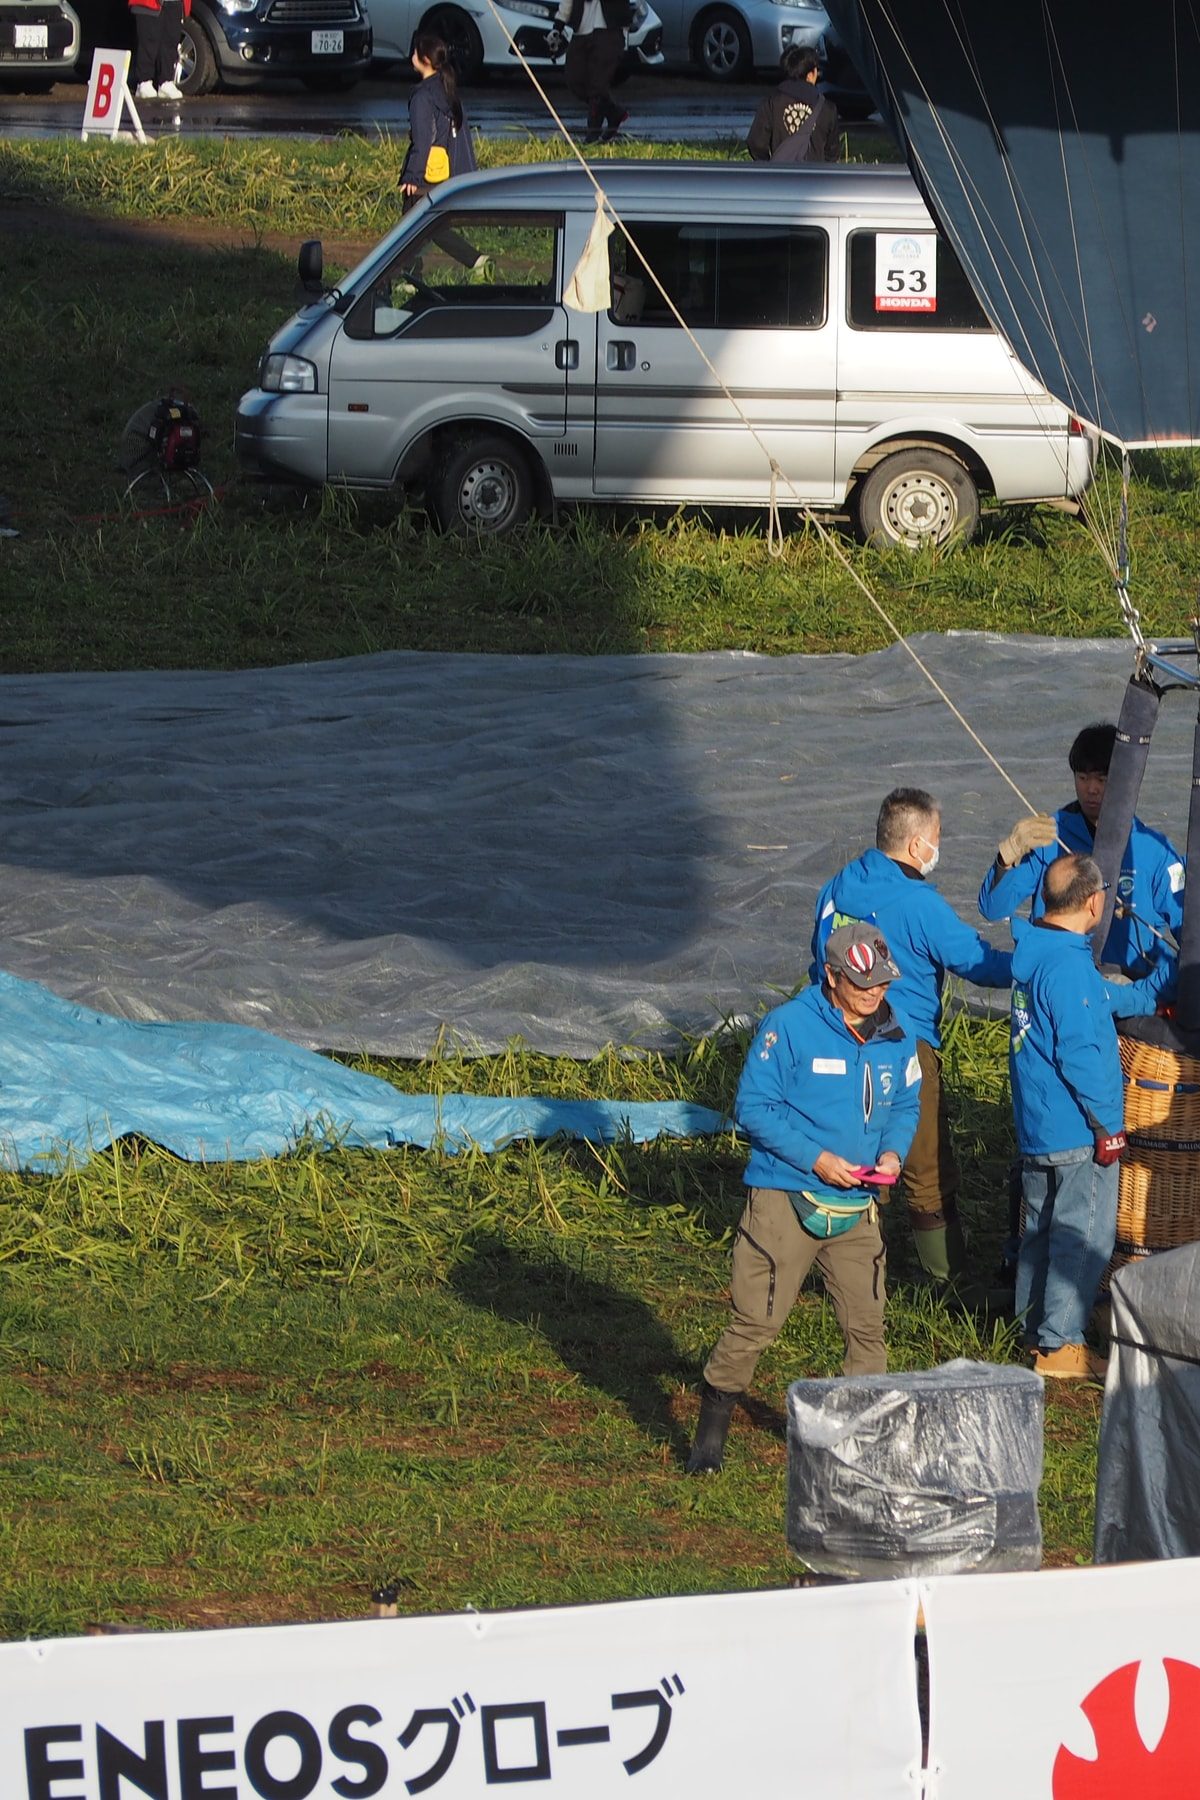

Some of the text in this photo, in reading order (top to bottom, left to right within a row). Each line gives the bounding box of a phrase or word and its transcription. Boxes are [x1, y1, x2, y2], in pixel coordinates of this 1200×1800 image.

[92, 63, 115, 118] B
[886, 269, 928, 293] 53
[880, 297, 931, 308] HONDA
[23, 1673, 687, 1800] ENEOSグローブ
